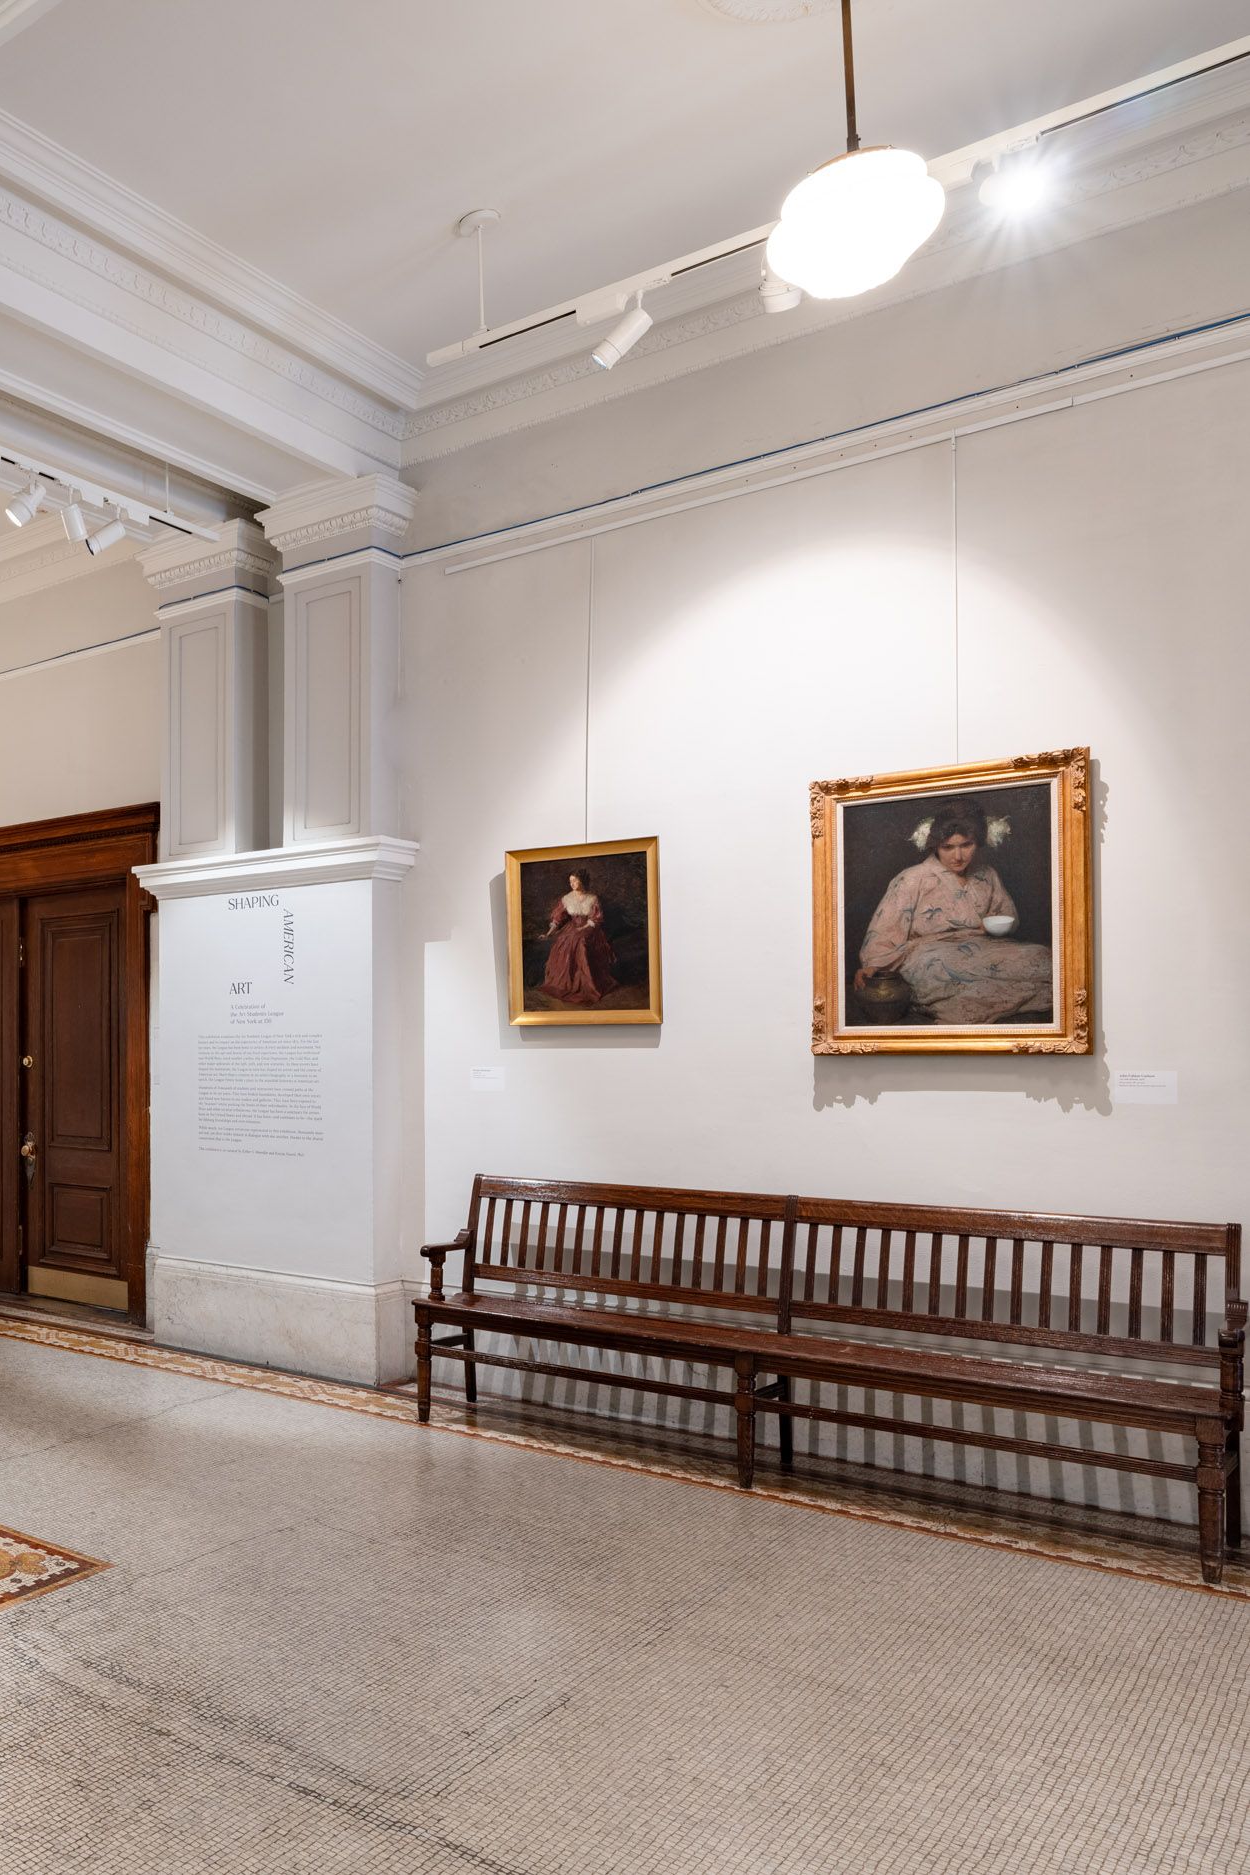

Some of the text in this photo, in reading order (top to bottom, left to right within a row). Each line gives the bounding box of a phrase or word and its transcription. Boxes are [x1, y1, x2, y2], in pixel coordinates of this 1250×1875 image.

[228, 894, 279, 911] SHAPING
[283, 908, 294, 985] AMERICAN
[229, 981, 252, 995] ART
